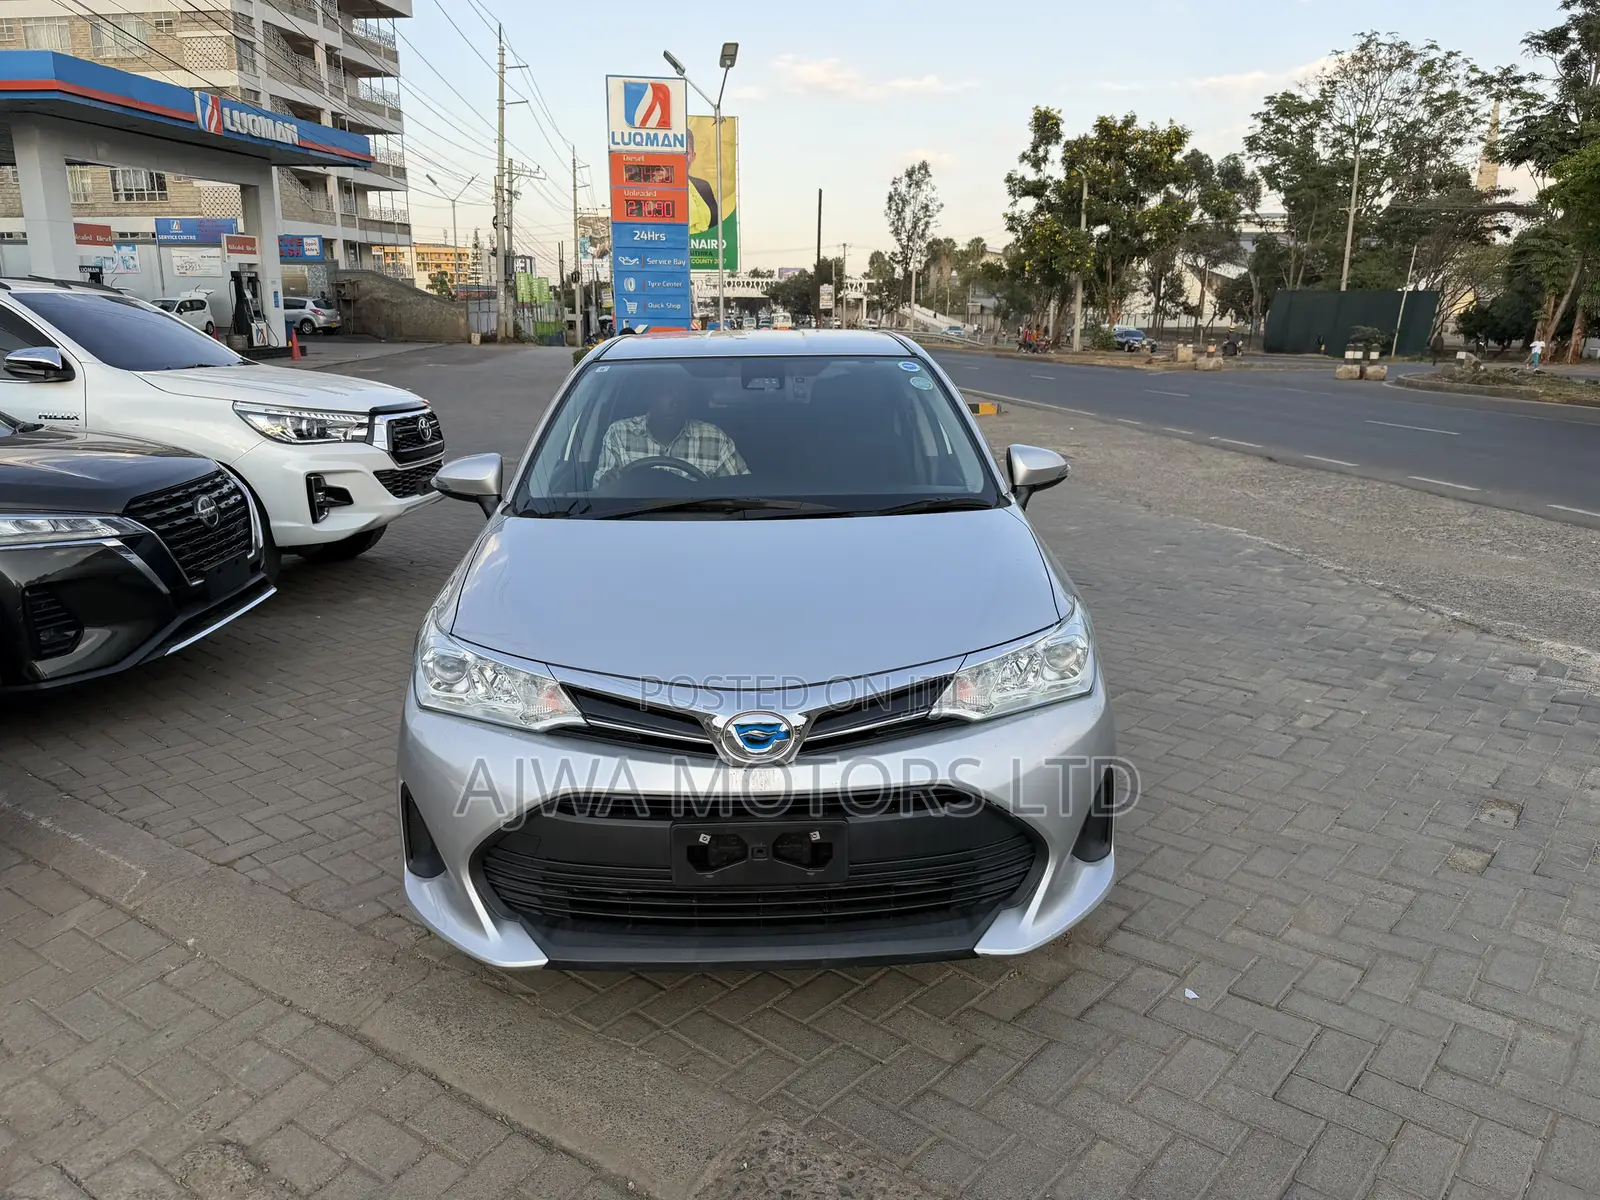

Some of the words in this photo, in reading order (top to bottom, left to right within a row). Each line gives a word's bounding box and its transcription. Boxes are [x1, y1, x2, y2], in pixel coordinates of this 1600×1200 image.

[223, 107, 299, 146] LUQMAN
[611, 131, 684, 148] LUQMAN
[624, 189, 657, 197] Unleaded
[633, 230, 666, 241] 24Hrs
[673, 259, 686, 267] Bay
[666, 302, 681, 310] Shop
[38, 412, 81, 421] HILUX
